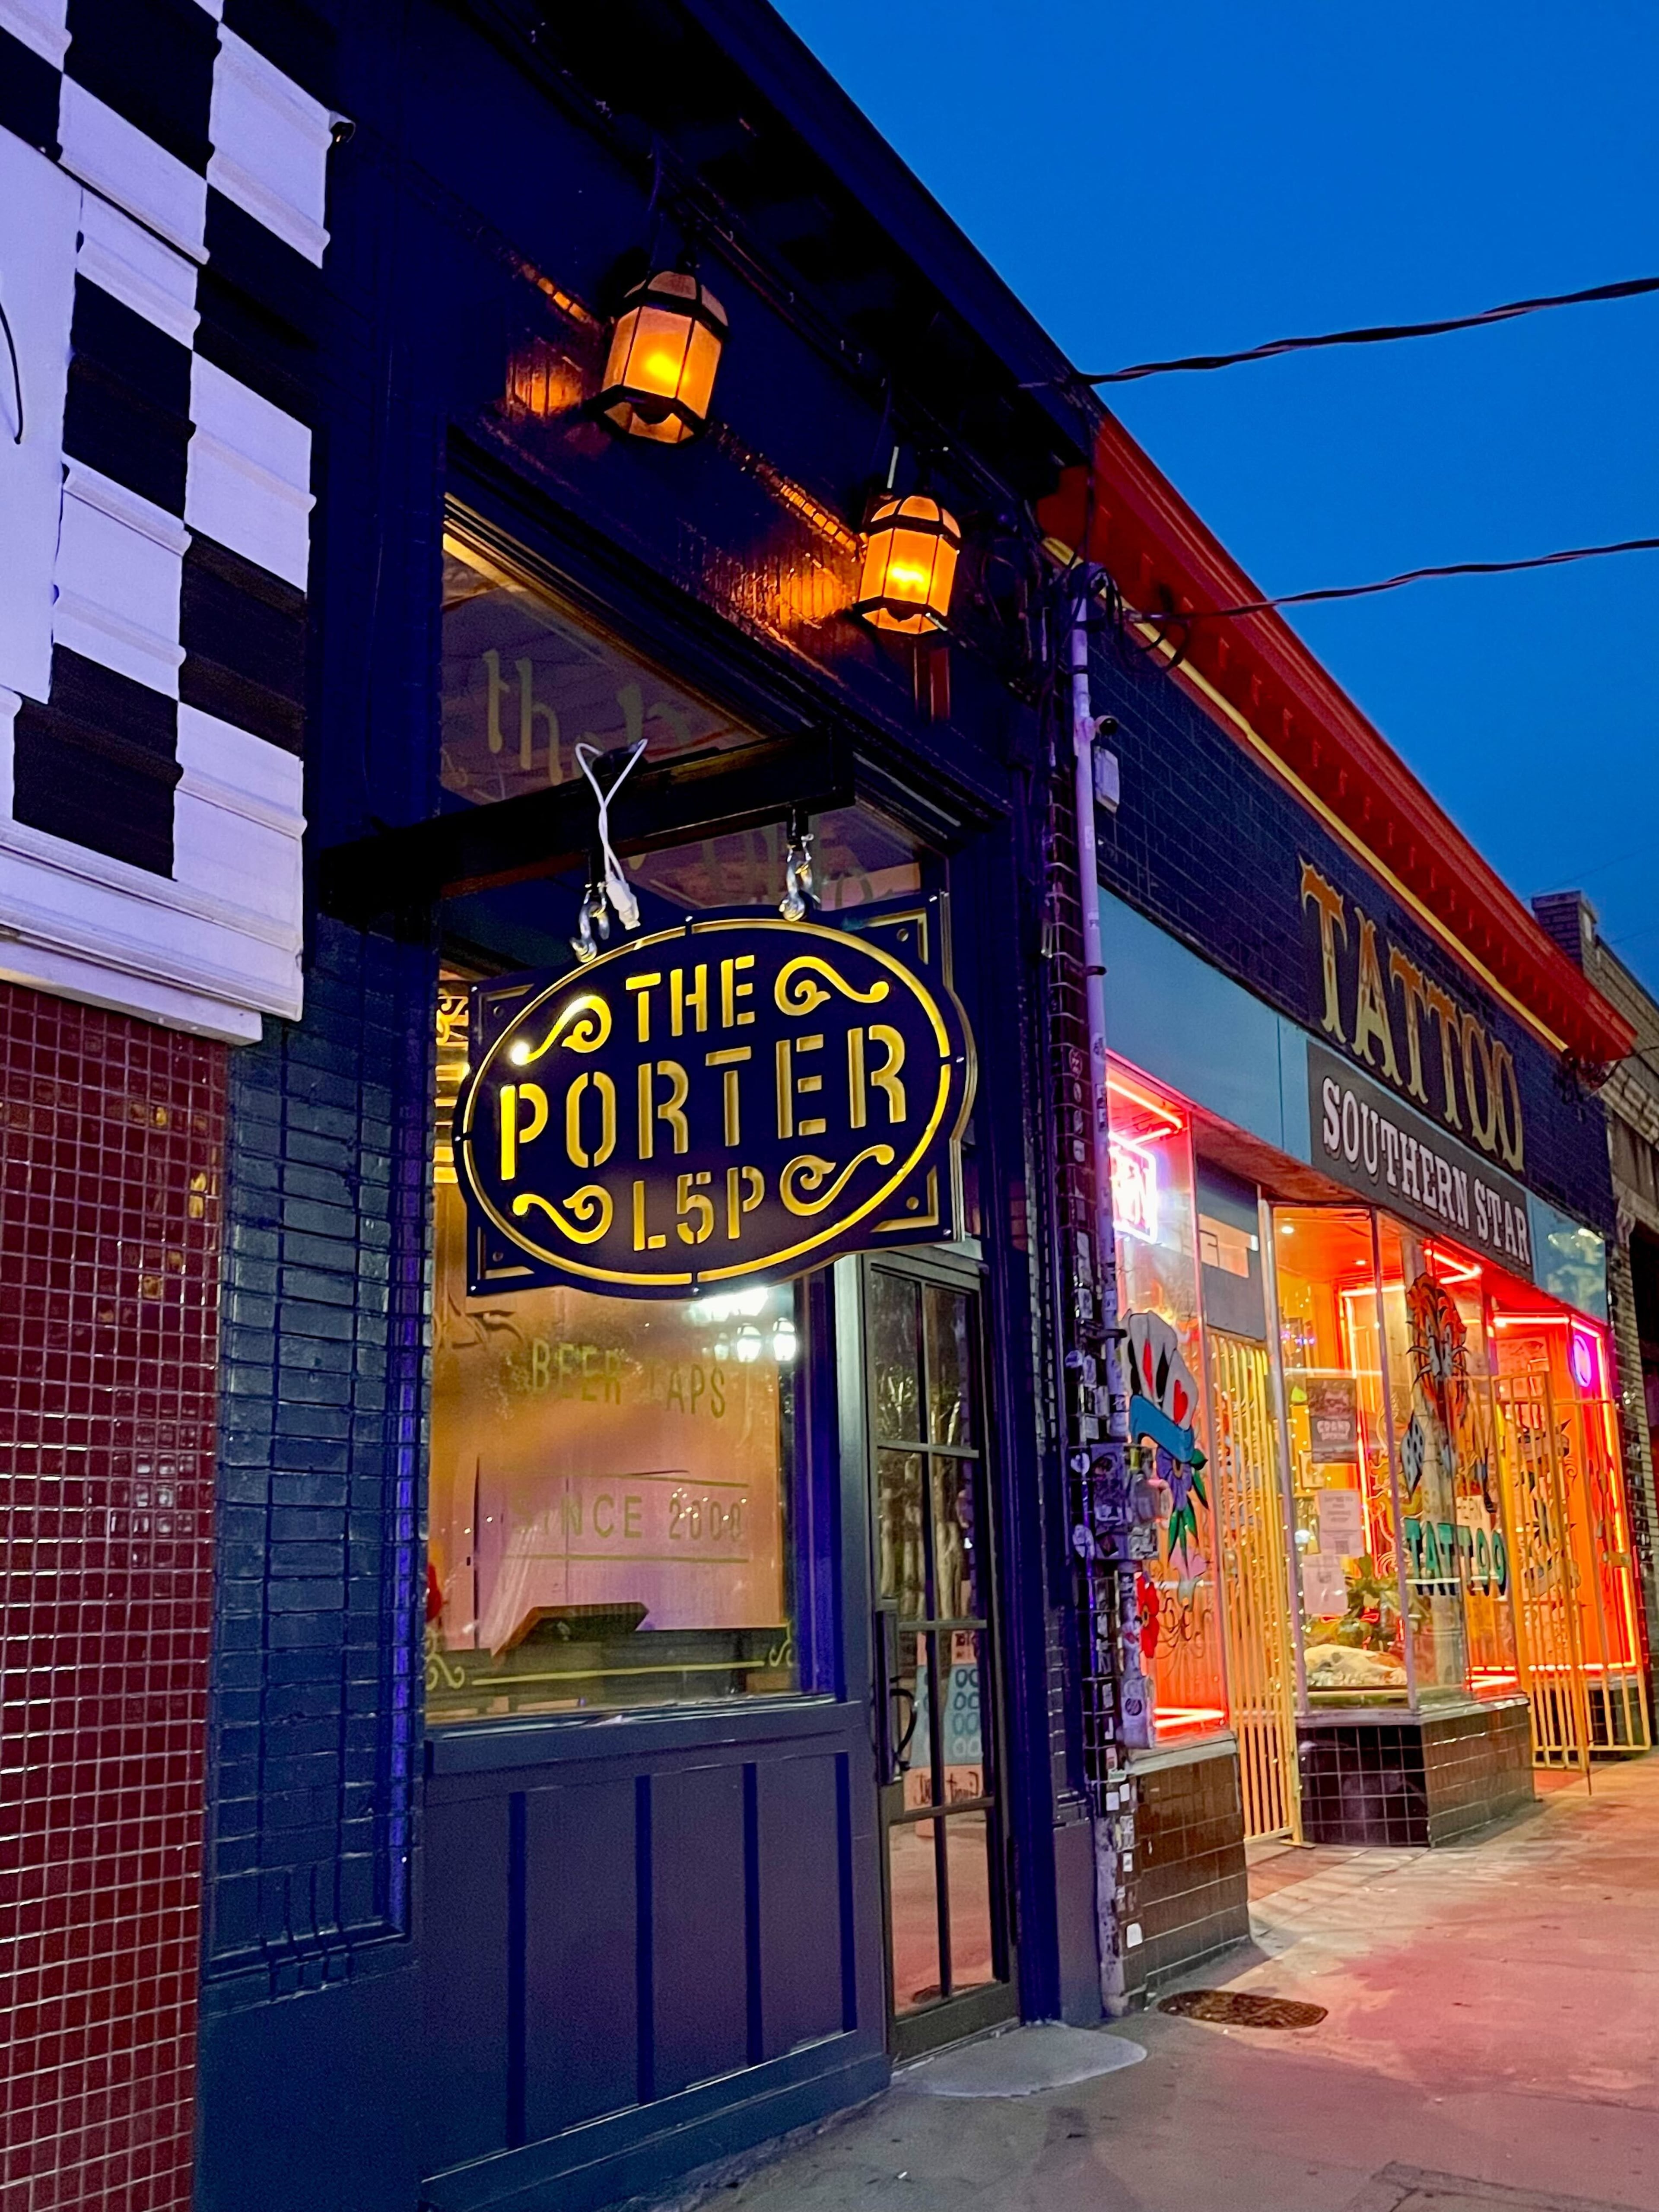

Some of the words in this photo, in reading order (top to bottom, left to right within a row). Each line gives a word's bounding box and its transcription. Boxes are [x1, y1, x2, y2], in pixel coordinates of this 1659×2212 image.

[626, 955, 755, 1042] THE
[1299, 854, 1525, 1172] TATTOO
[500, 1024, 906, 1181] PORTER
[632, 1166, 766, 1252] L5P
[1322, 1077, 1468, 1230] SOUTHERN
[1474, 1177, 1531, 1265] STAR
[533, 1338, 621, 1404] BEER
[645, 1357, 726, 1419] TAPS
[1404, 1517, 1508, 1592] TATTOO
